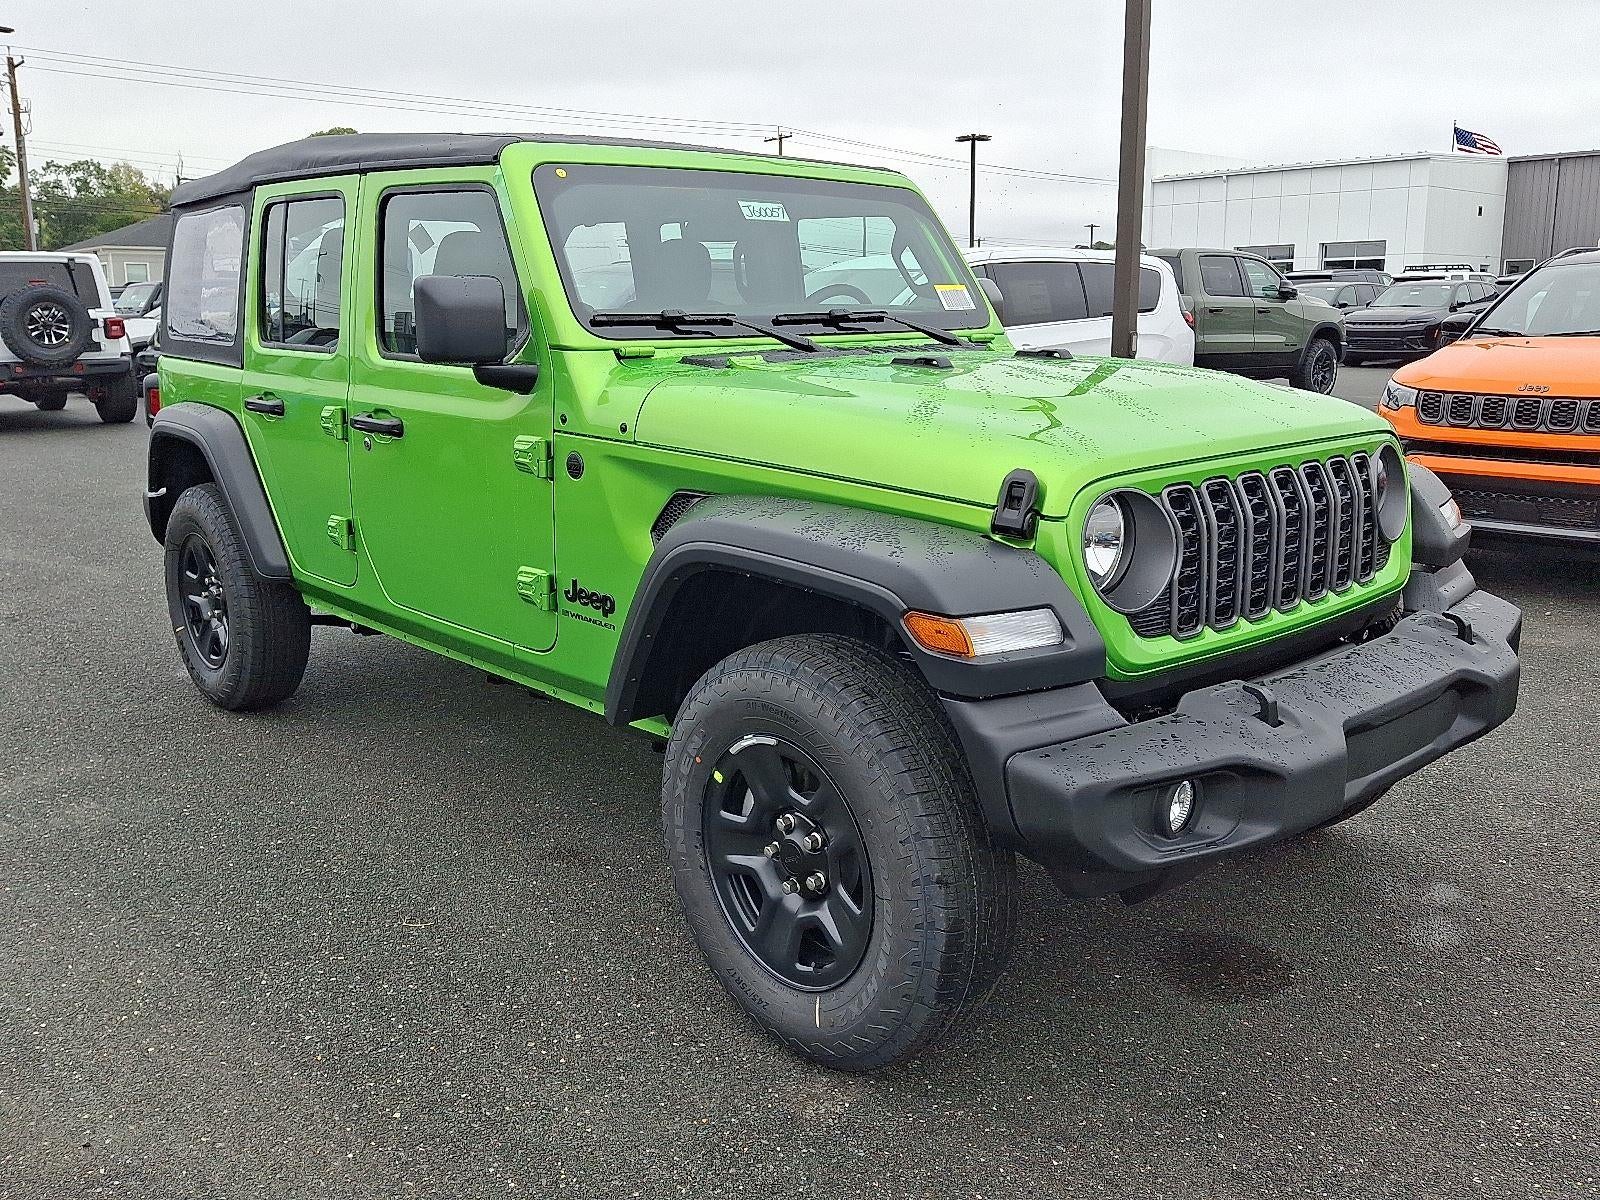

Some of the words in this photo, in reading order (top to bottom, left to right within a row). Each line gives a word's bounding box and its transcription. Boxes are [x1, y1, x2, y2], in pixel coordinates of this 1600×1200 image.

[1517, 384, 1550, 393] Jeep
[564, 578, 616, 618] Jeep
[569, 612, 616, 631] WRANGLER
